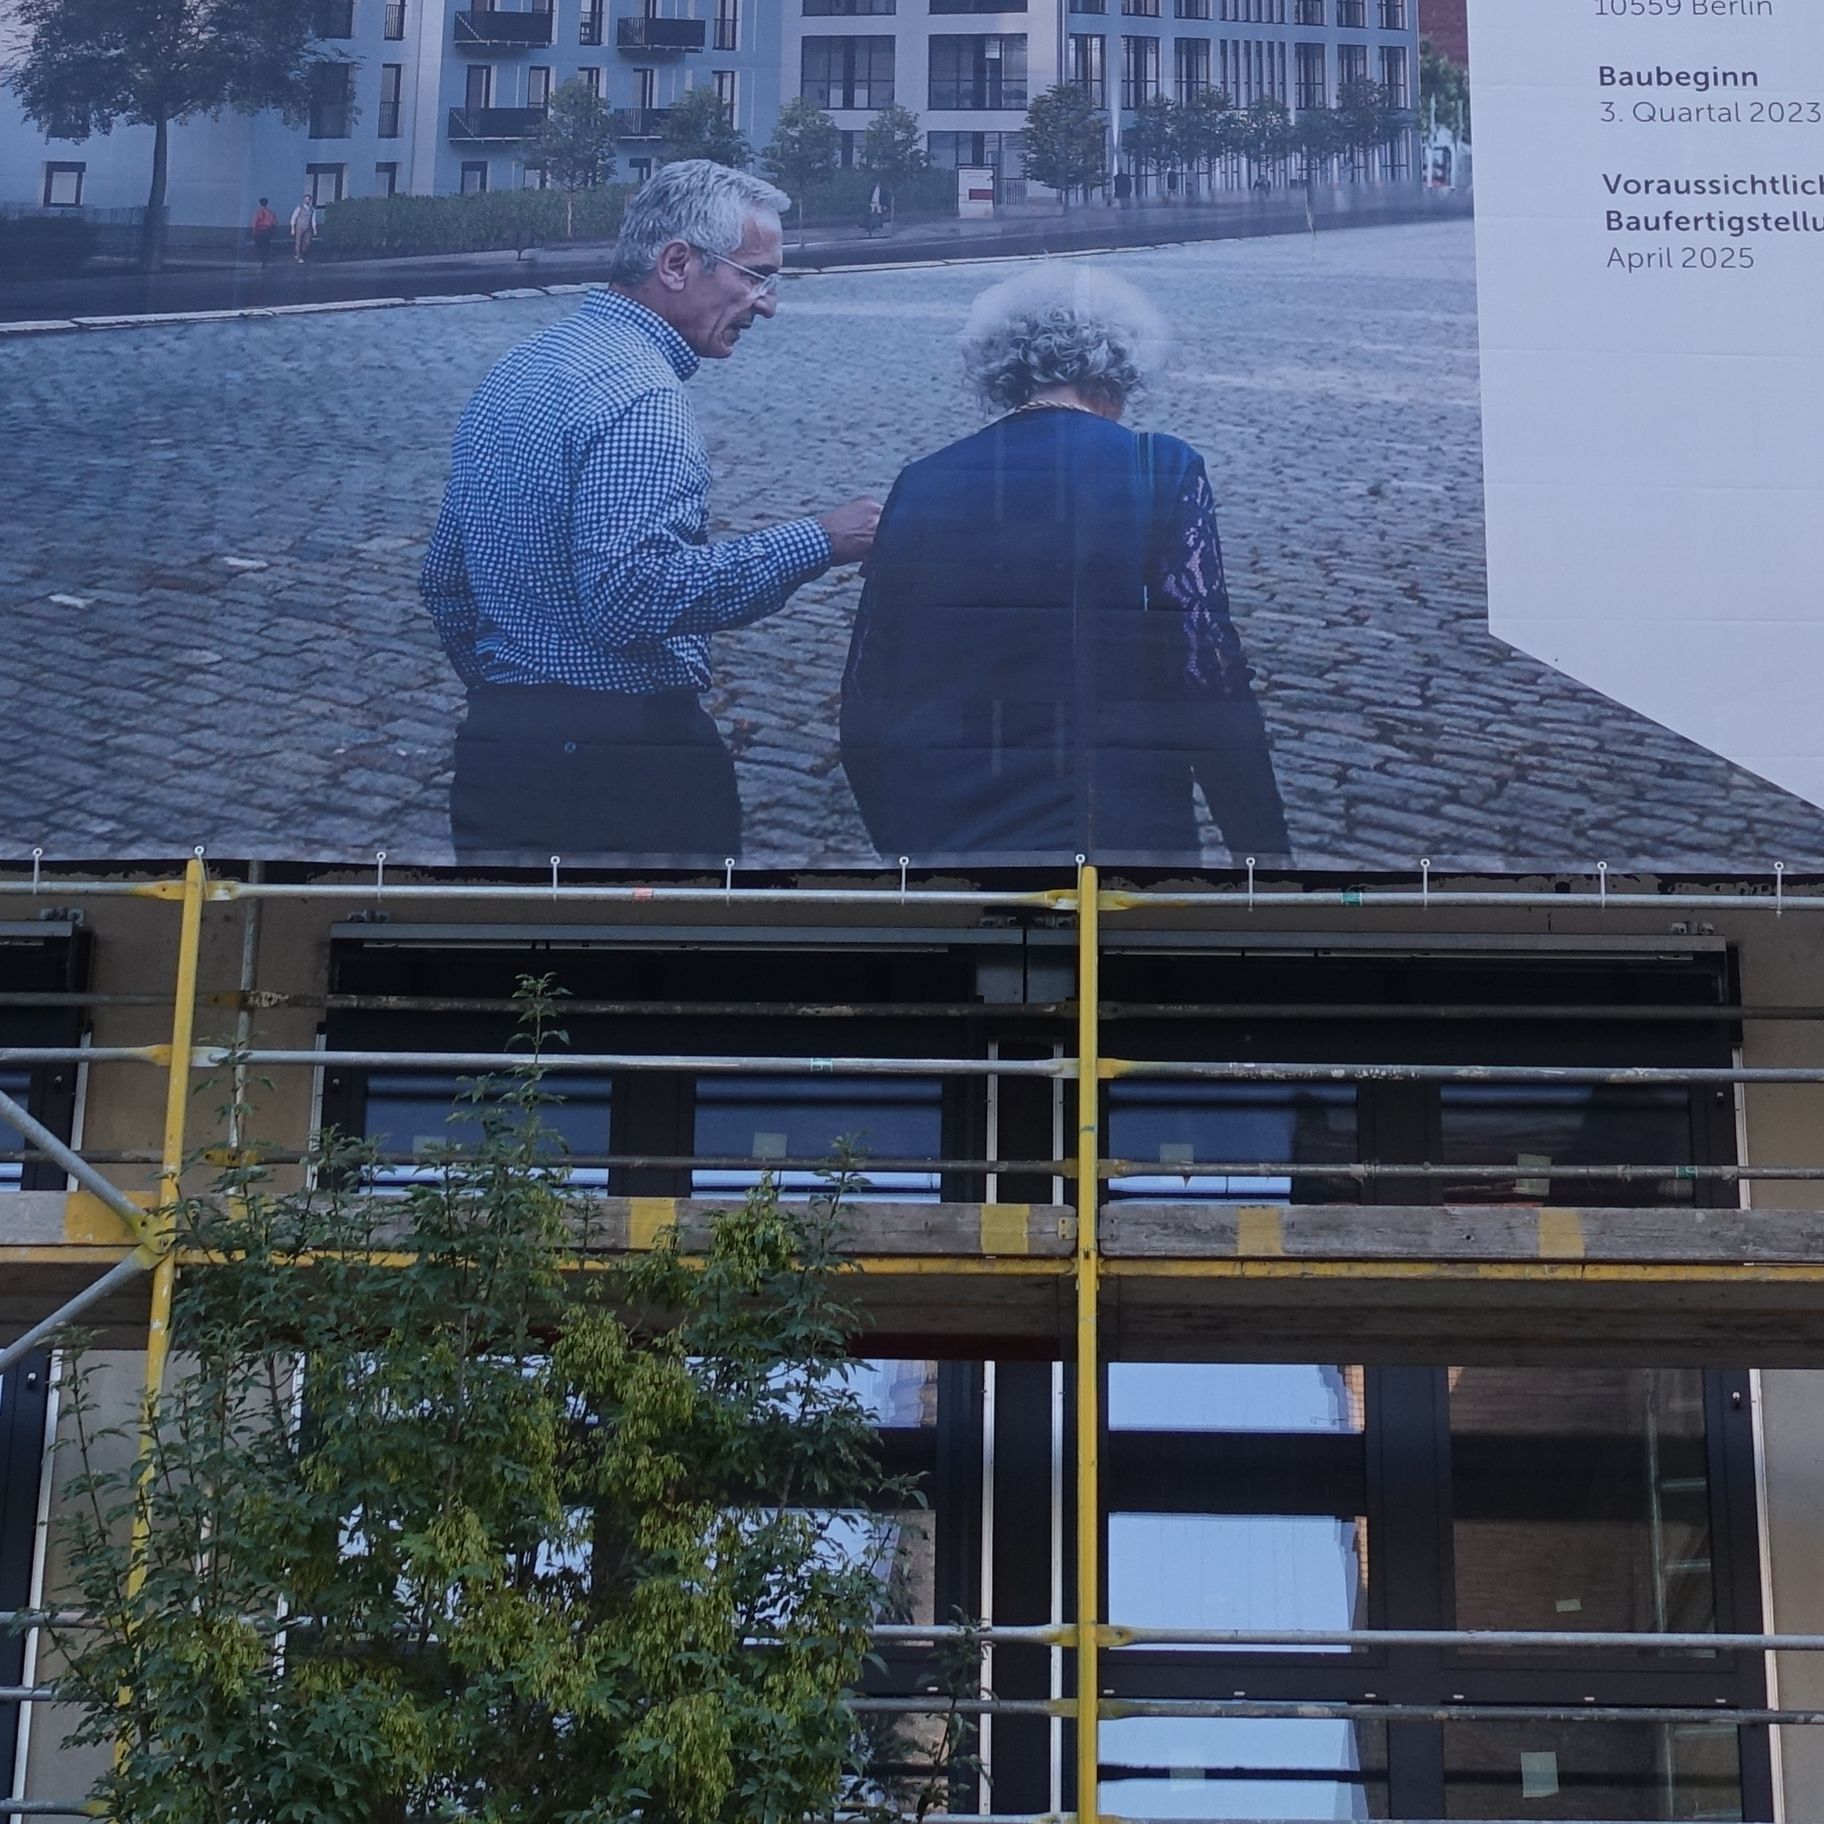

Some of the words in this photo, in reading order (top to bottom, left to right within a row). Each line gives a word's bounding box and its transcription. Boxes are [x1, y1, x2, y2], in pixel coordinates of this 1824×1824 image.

[1599, 65, 1758, 93] Baubeginn
[1599, 101, 1624, 123] 3.
[1632, 101, 1742, 123] Quartal
[1749, 101, 1822, 123] 2023
[1606, 246, 1673, 274] April
[1681, 246, 1754, 269] 2025
